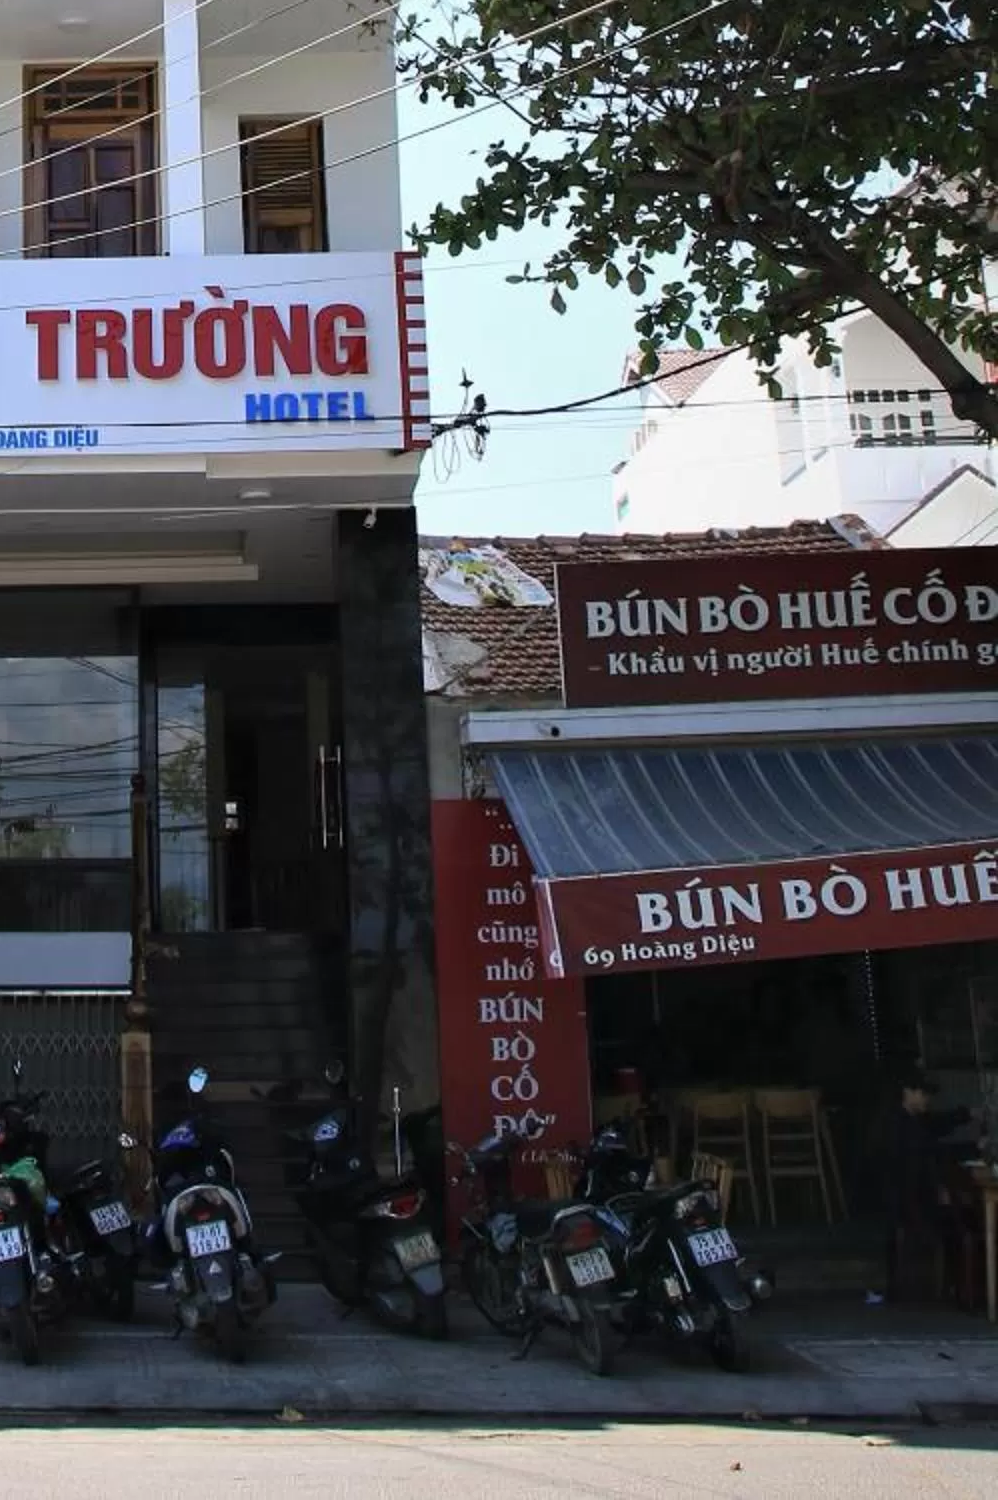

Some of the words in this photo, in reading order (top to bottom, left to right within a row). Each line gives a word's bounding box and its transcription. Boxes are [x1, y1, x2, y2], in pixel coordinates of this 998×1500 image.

[25, 285, 369, 381] TRƯỜNG
[245, 391, 375, 423] HOTEL
[53, 424, 99, 451] DIỆU
[585, 589, 690, 639] BÚN
[698, 584, 770, 633] BÒ
[777, 571, 877, 629] HUẾ
[883, 567, 957, 625] CỐ
[608, 646, 685, 676] Khẩu
[692, 648, 719, 677] vị
[727, 644, 812, 676] người
[821, 637, 880, 666] Huế
[887, 637, 969, 664] chính
[976, 642, 998, 666] g
[489, 843, 519, 867] Đi
[486, 880, 527, 905] mô
[636, 877, 763, 933] BÚN
[781, 863, 867, 921] BÒ
[477, 921, 539, 949] cũng
[583, 946, 615, 968] 69
[621, 938, 696, 963] Hoàng
[703, 934, 756, 958] Diệu
[485, 955, 536, 981] nhớ
[478, 991, 544, 1023] BÚN
[490, 1030, 536, 1062] BÒ
[490, 1064, 539, 1101] CỐ
